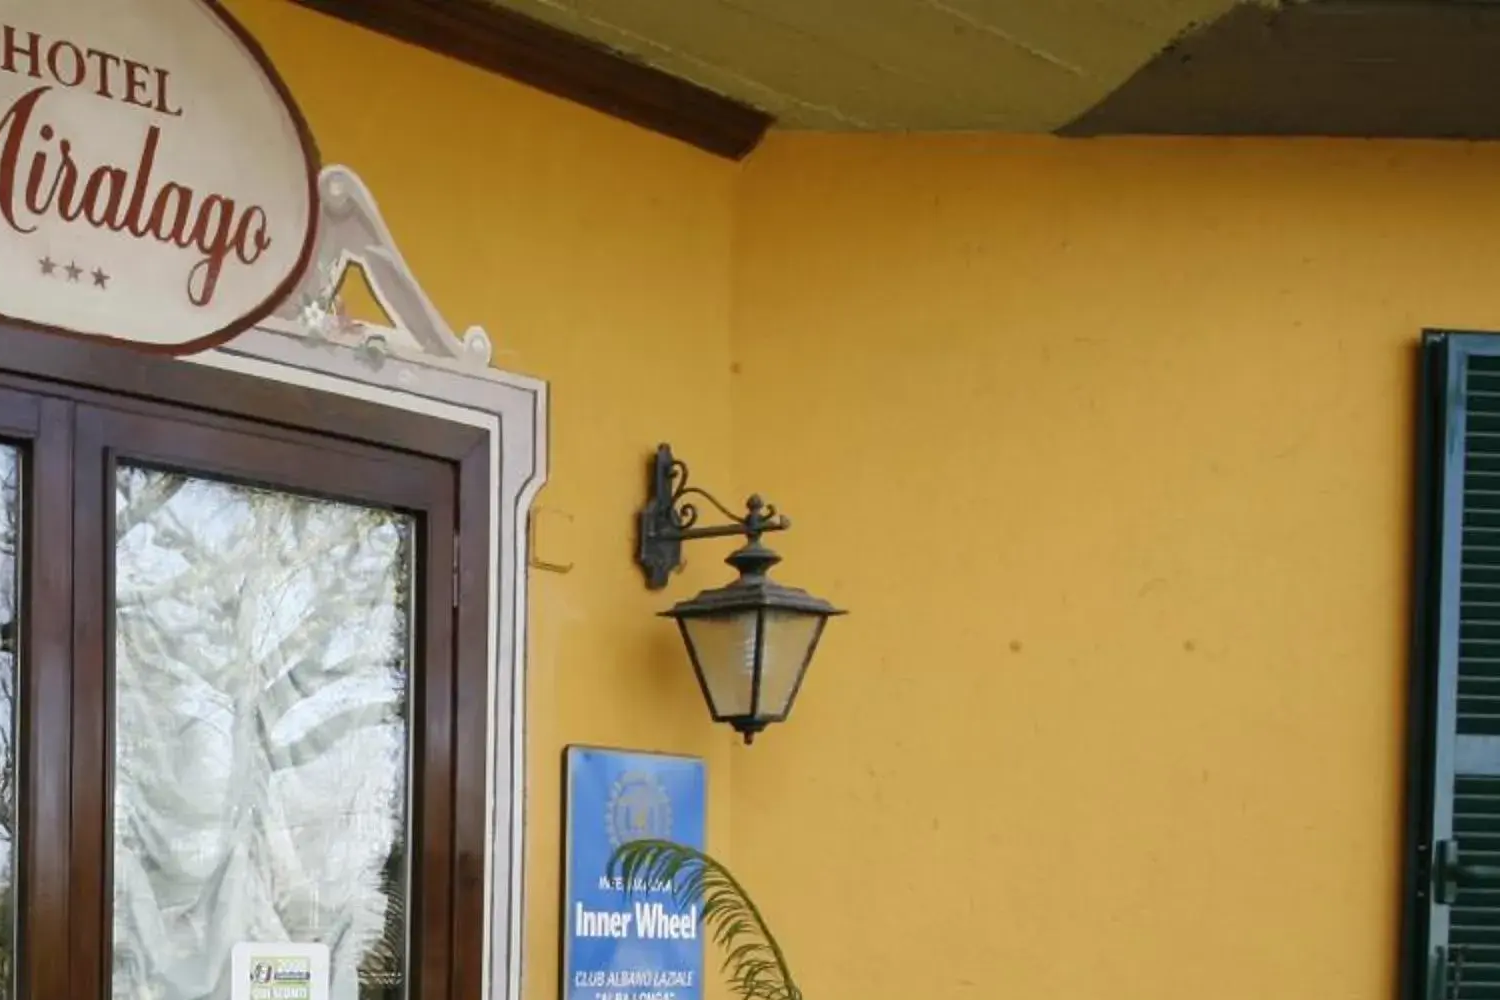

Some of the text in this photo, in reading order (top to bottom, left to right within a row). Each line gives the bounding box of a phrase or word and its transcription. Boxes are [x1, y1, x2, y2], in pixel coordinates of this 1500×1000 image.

[1, 26, 182, 117] HOTEL
[575, 900, 698, 939] Inner Wheel
[575, 970, 605, 988] CLUB
[607, 970, 651, 988] ALBANO
